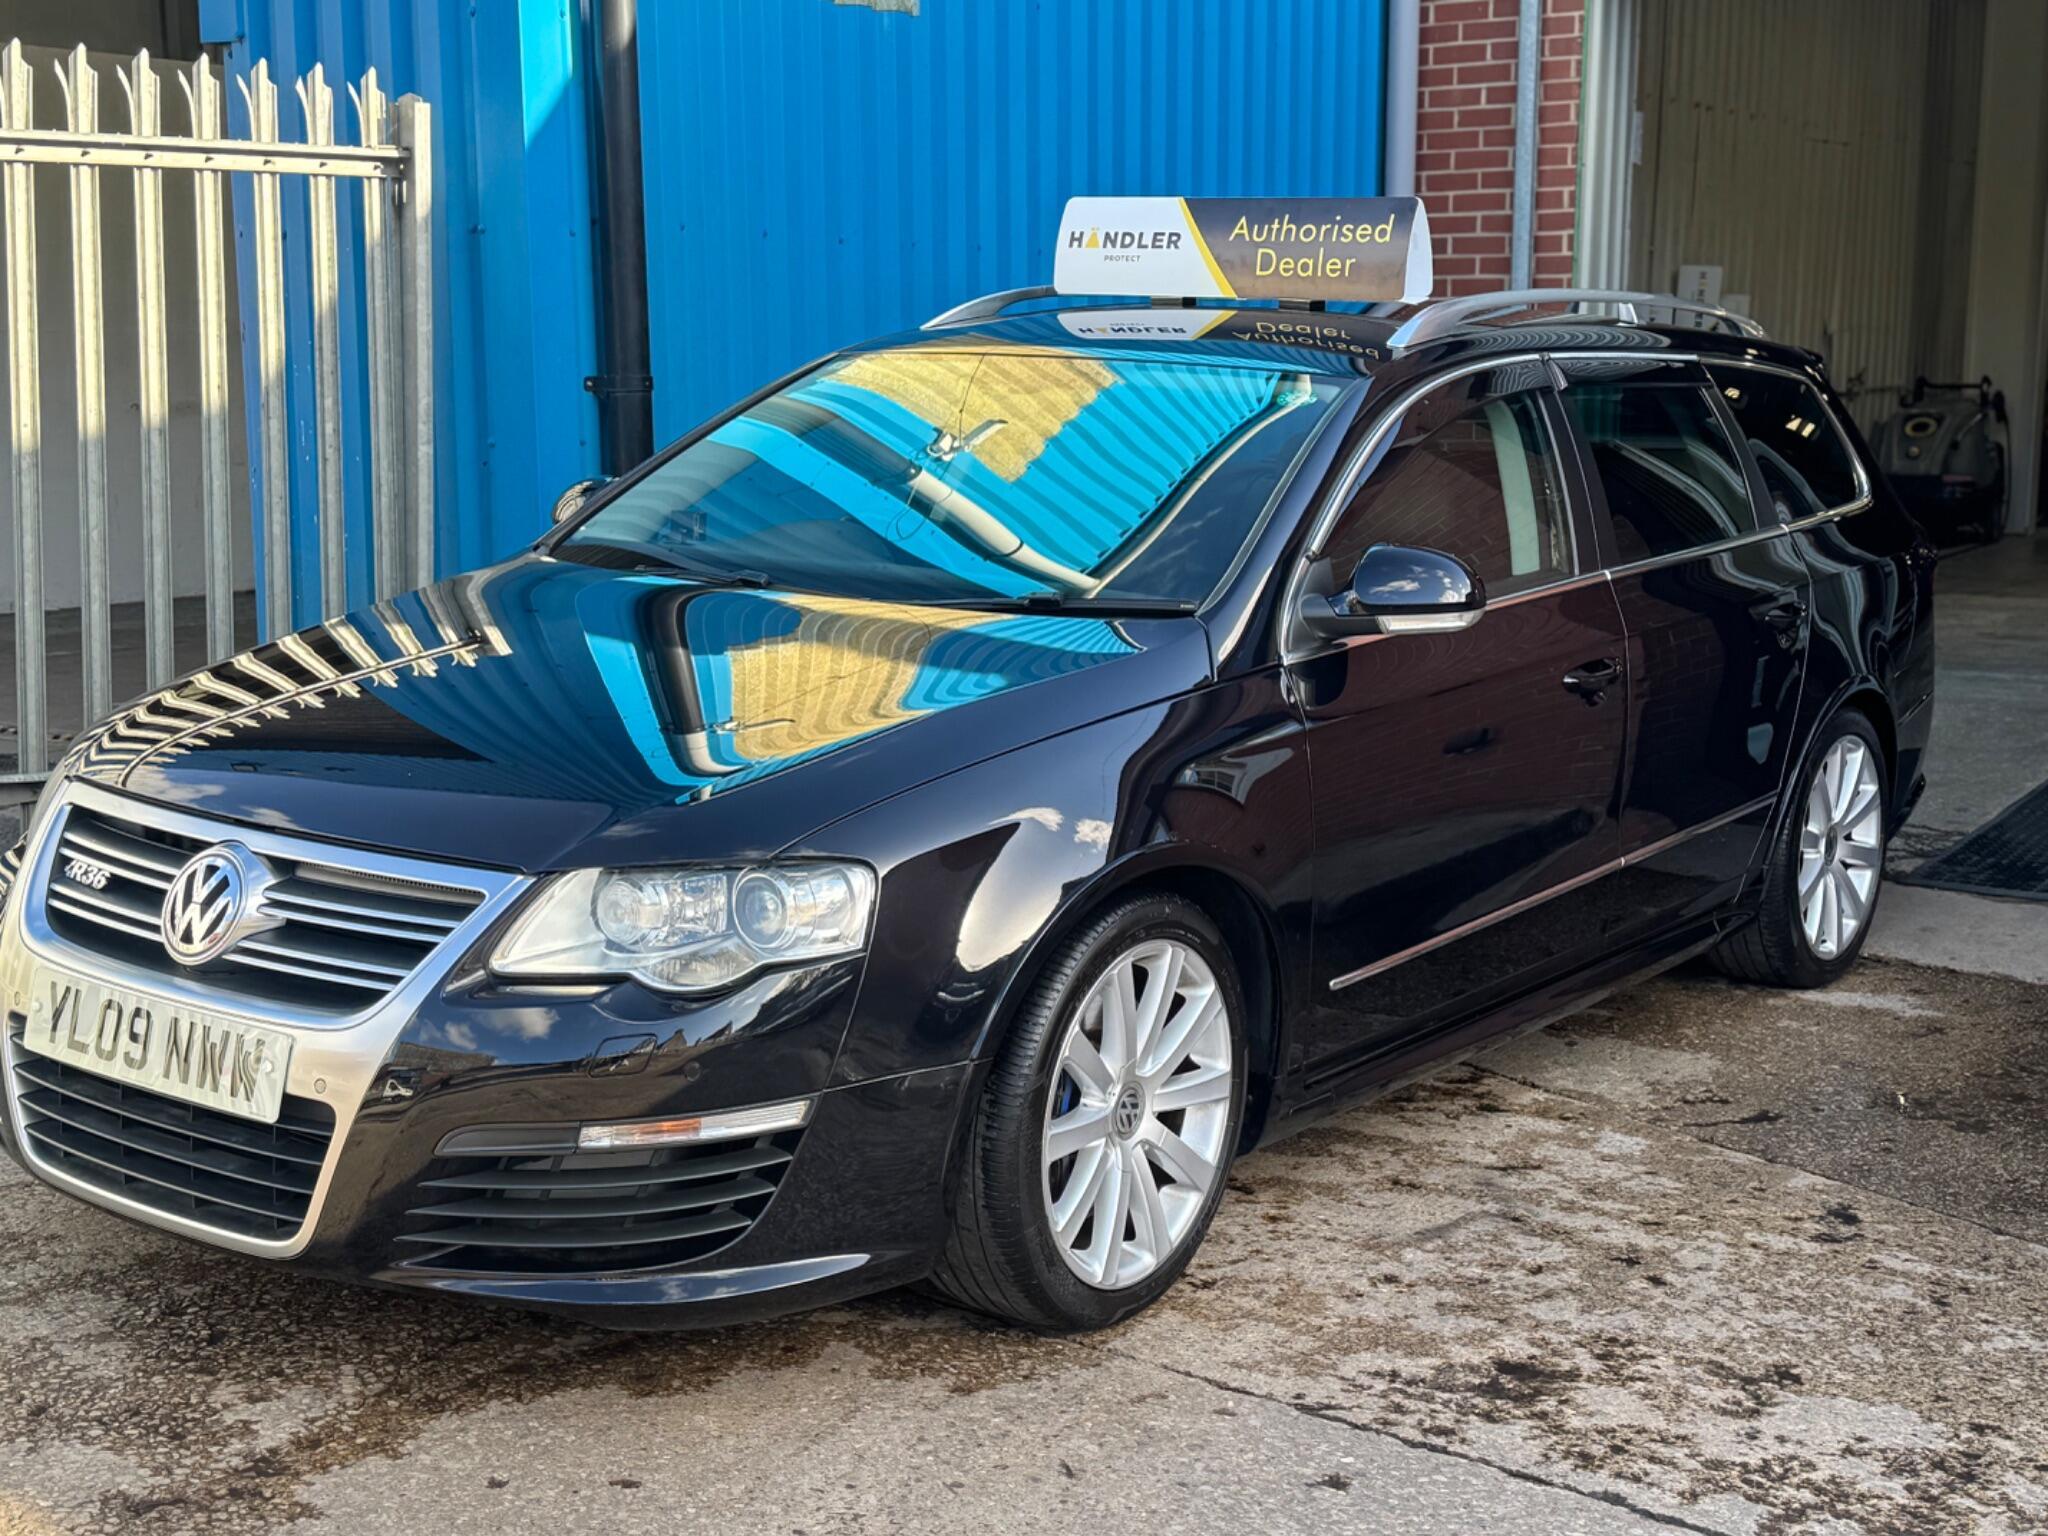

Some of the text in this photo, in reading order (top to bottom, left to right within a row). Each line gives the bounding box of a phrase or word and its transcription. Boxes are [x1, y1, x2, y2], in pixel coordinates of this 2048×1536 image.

[1068, 227, 1182, 249] HÄNDLER
[1229, 213, 1396, 243] Authorised
[1104, 254, 1141, 263] PROTECT
[1256, 248, 1357, 278] Dealer
[68, 859, 112, 890] R36
[49, 981, 265, 1102] YL09 NWK
